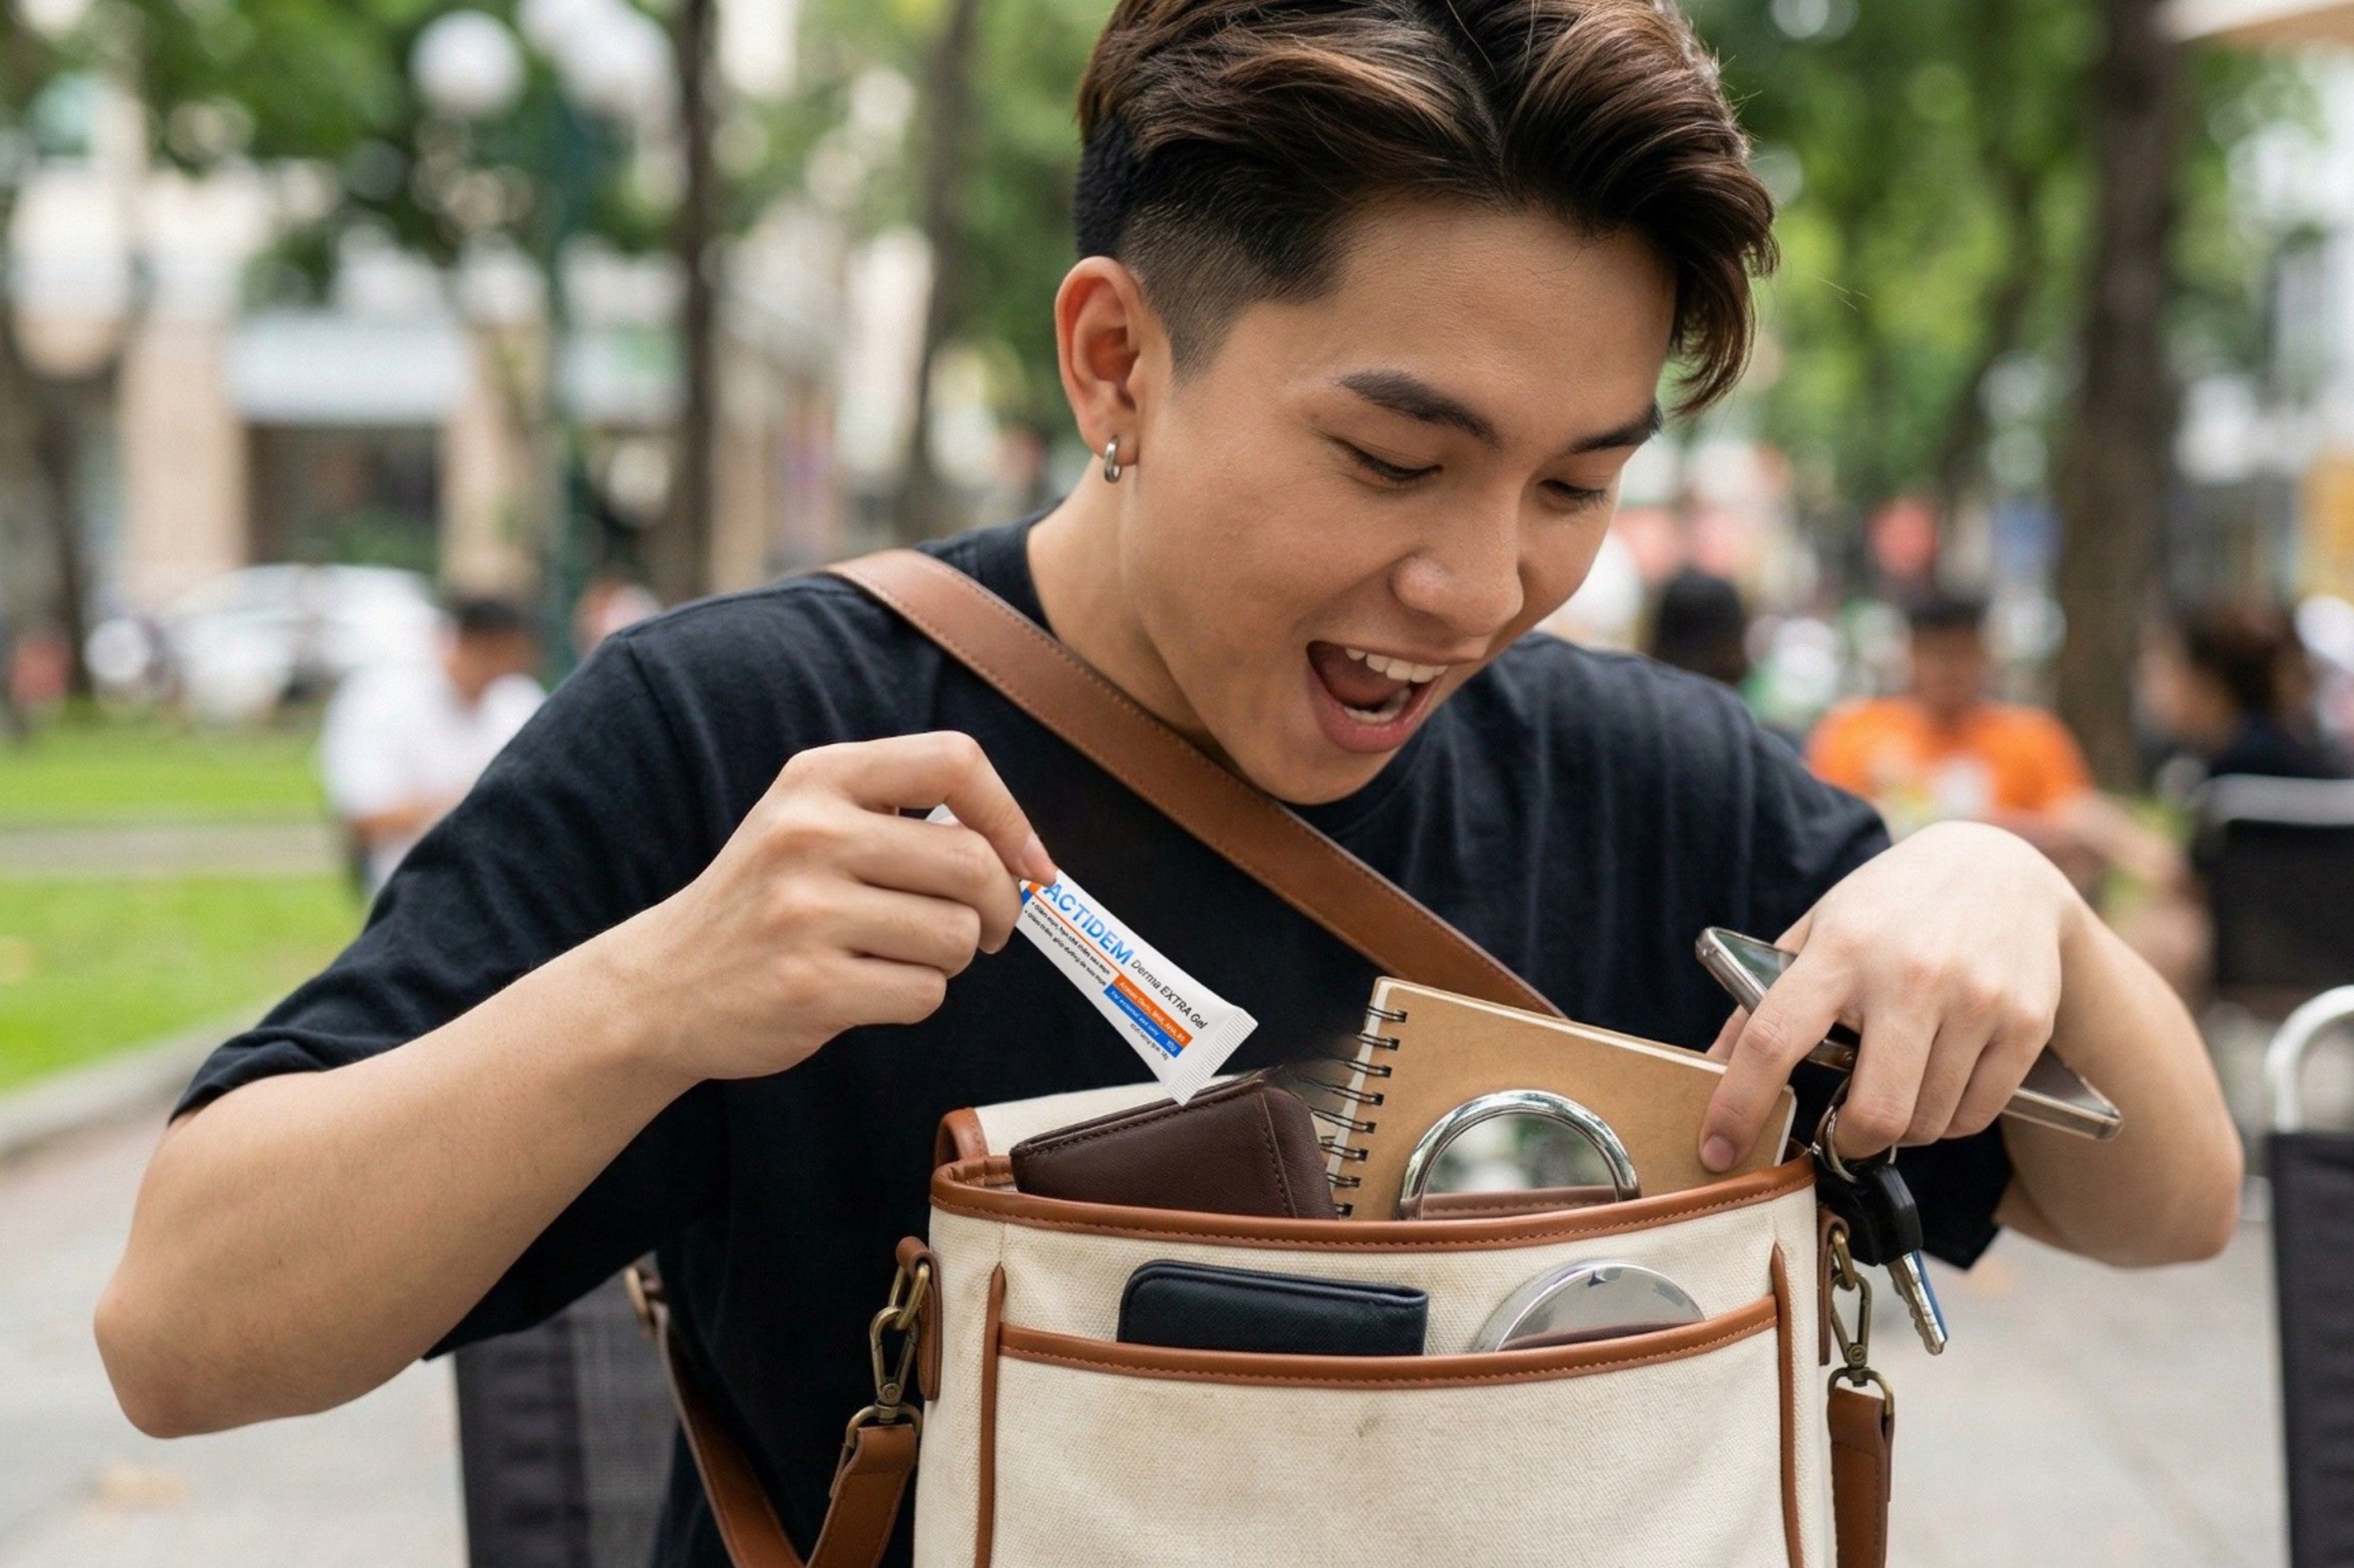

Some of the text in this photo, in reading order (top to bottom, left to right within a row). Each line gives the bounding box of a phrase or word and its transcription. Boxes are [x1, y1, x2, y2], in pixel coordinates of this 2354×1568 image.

[1043, 884, 1208, 1029] ACTIDEM Derma EXTRA Gel
